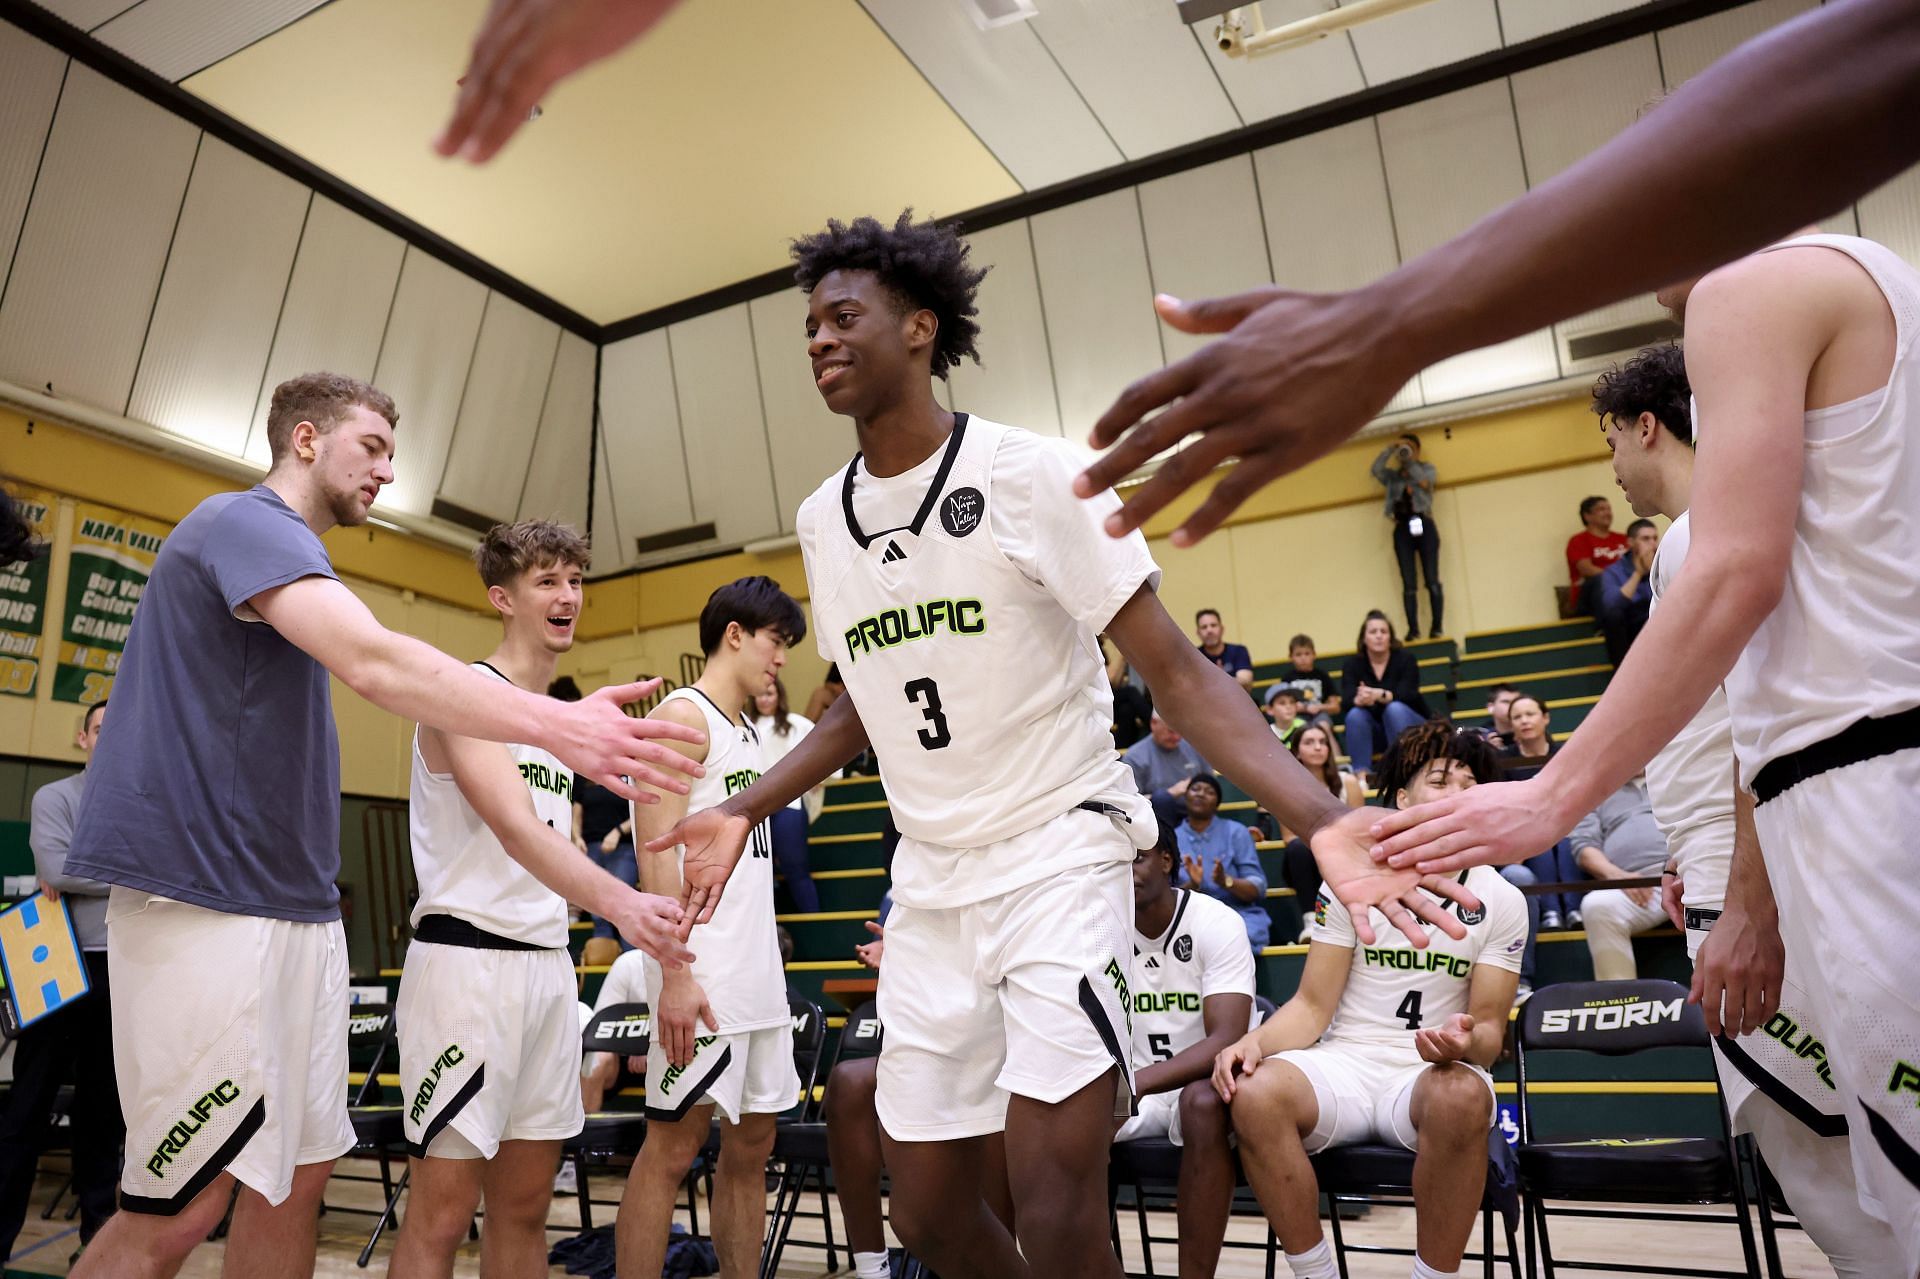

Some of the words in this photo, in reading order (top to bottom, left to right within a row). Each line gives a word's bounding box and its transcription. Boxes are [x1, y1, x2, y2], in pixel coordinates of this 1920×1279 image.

[81, 519, 125, 544] NAPA
[950, 511, 979, 531] Valley
[844, 599, 985, 663] PROLIFIC
[903, 677, 951, 751] 3
[517, 762, 574, 805] PROLIFI
[724, 768, 763, 797] PRO
[1363, 948, 1470, 978] PROLIFIC
[1395, 990, 1423, 1030] 4
[1541, 998, 1685, 1033] STORM
[1584, 1000, 1607, 1008] NAPA
[1609, 996, 1640, 1006] VALLEY
[1147, 1033, 1174, 1064] 5
[1757, 1012, 1837, 1091] OLIFI
[409, 1043, 465, 1128] PROLIFIC
[146, 1078, 241, 1180] PROLIFIC
